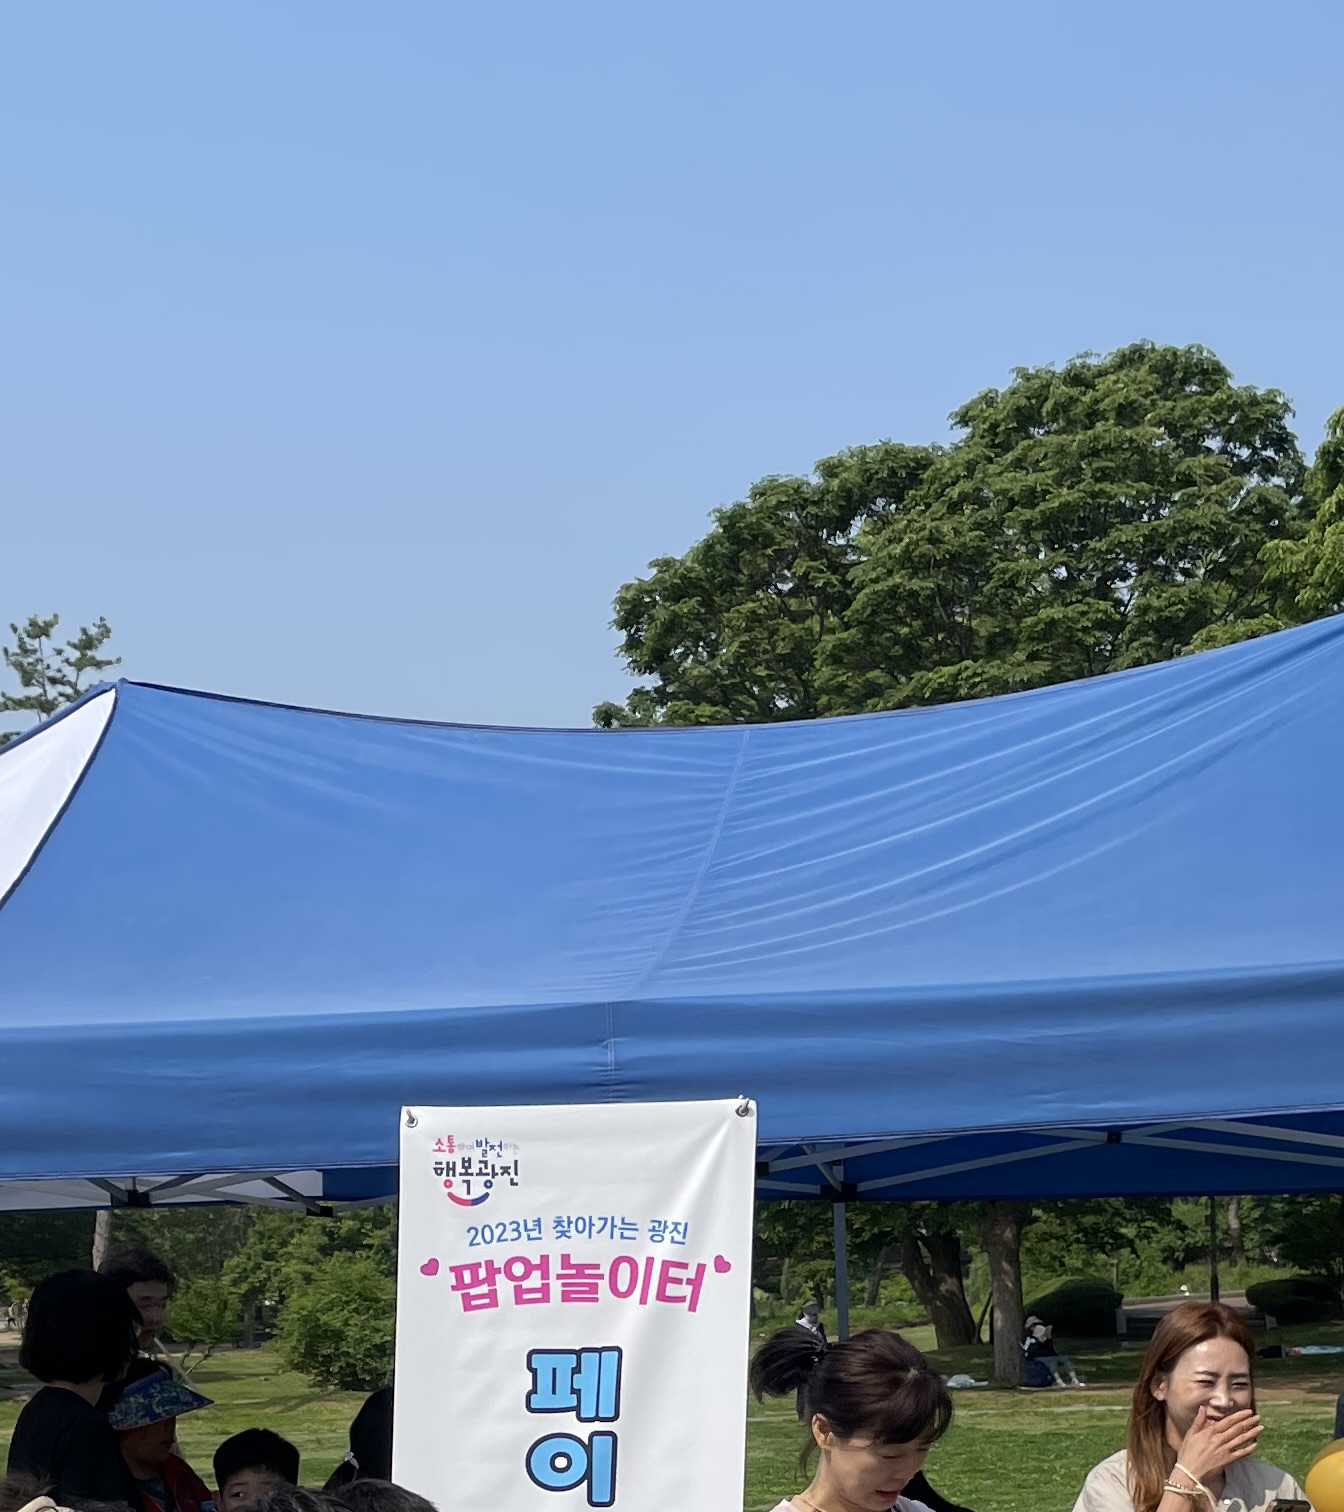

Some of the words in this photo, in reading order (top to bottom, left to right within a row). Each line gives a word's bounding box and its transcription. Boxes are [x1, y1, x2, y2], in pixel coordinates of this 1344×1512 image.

[432, 1134, 474, 1154] 소통하여
[433, 1157, 519, 1196] 행복광진
[466, 1217, 543, 1247] 2023년
[552, 1215, 639, 1241] 찾아가는
[647, 1219, 689, 1245] 광진
[449, 1253, 707, 1313] 팝업놀이터
